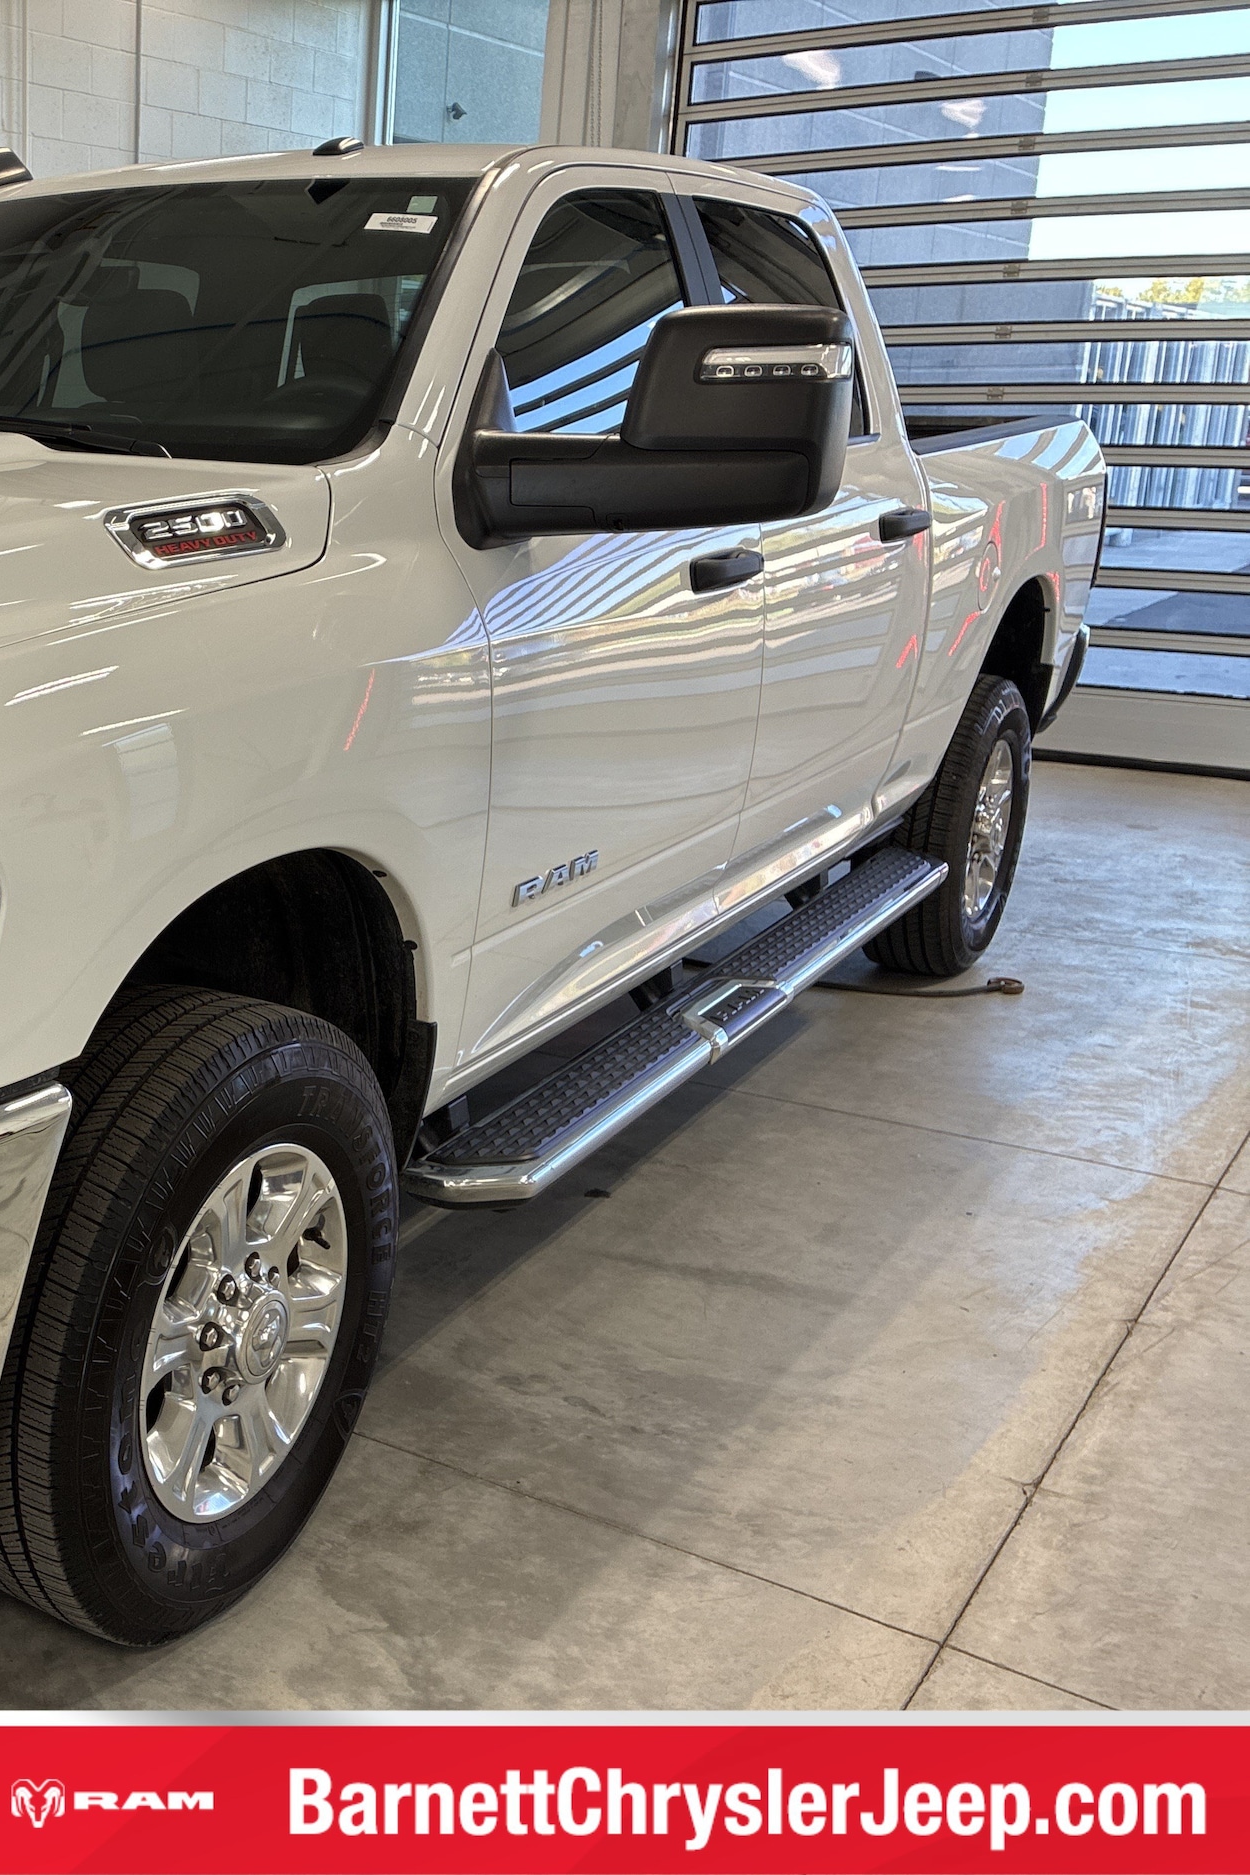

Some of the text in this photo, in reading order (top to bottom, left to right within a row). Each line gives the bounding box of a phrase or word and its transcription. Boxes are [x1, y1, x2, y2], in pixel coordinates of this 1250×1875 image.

[138, 510, 248, 540] 2500
[154, 531, 258, 555] HEAVY DUTY
[511, 849, 598, 907] RAM
[297, 1084, 393, 1265] TRANSFORCE
